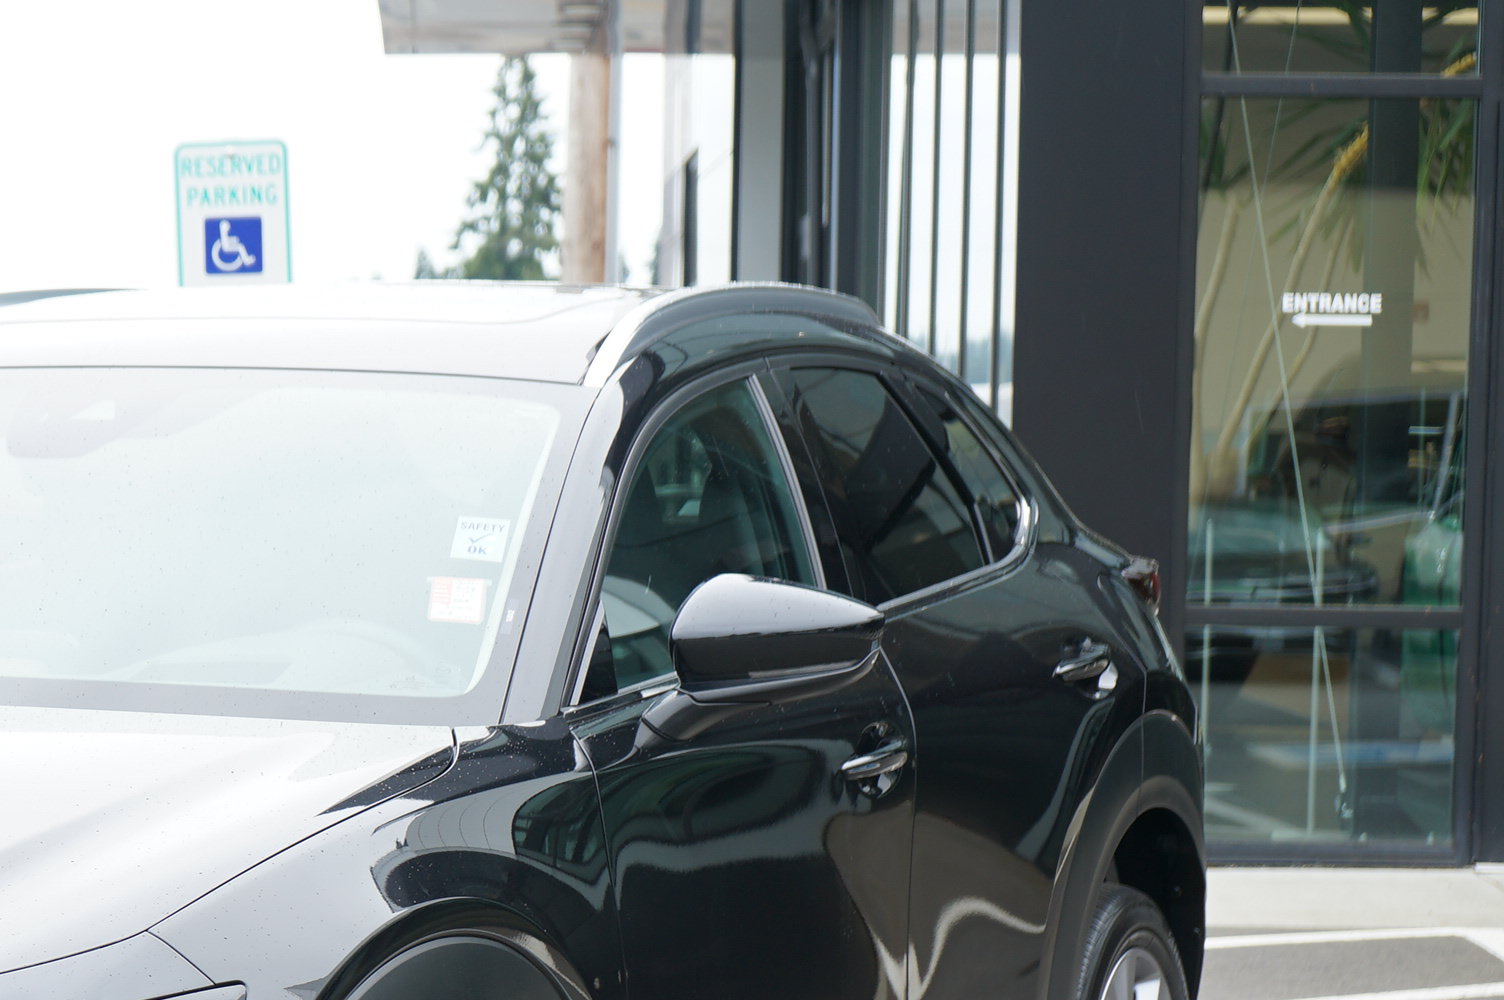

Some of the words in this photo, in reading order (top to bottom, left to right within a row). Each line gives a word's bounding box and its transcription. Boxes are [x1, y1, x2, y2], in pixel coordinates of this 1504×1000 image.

[181, 153, 281, 177] RESERVED
[187, 183, 278, 206] PARKING
[1282, 292, 1382, 314] ENTRANCE
[460, 521, 506, 532] SAFETY
[467, 545, 487, 555] OK
